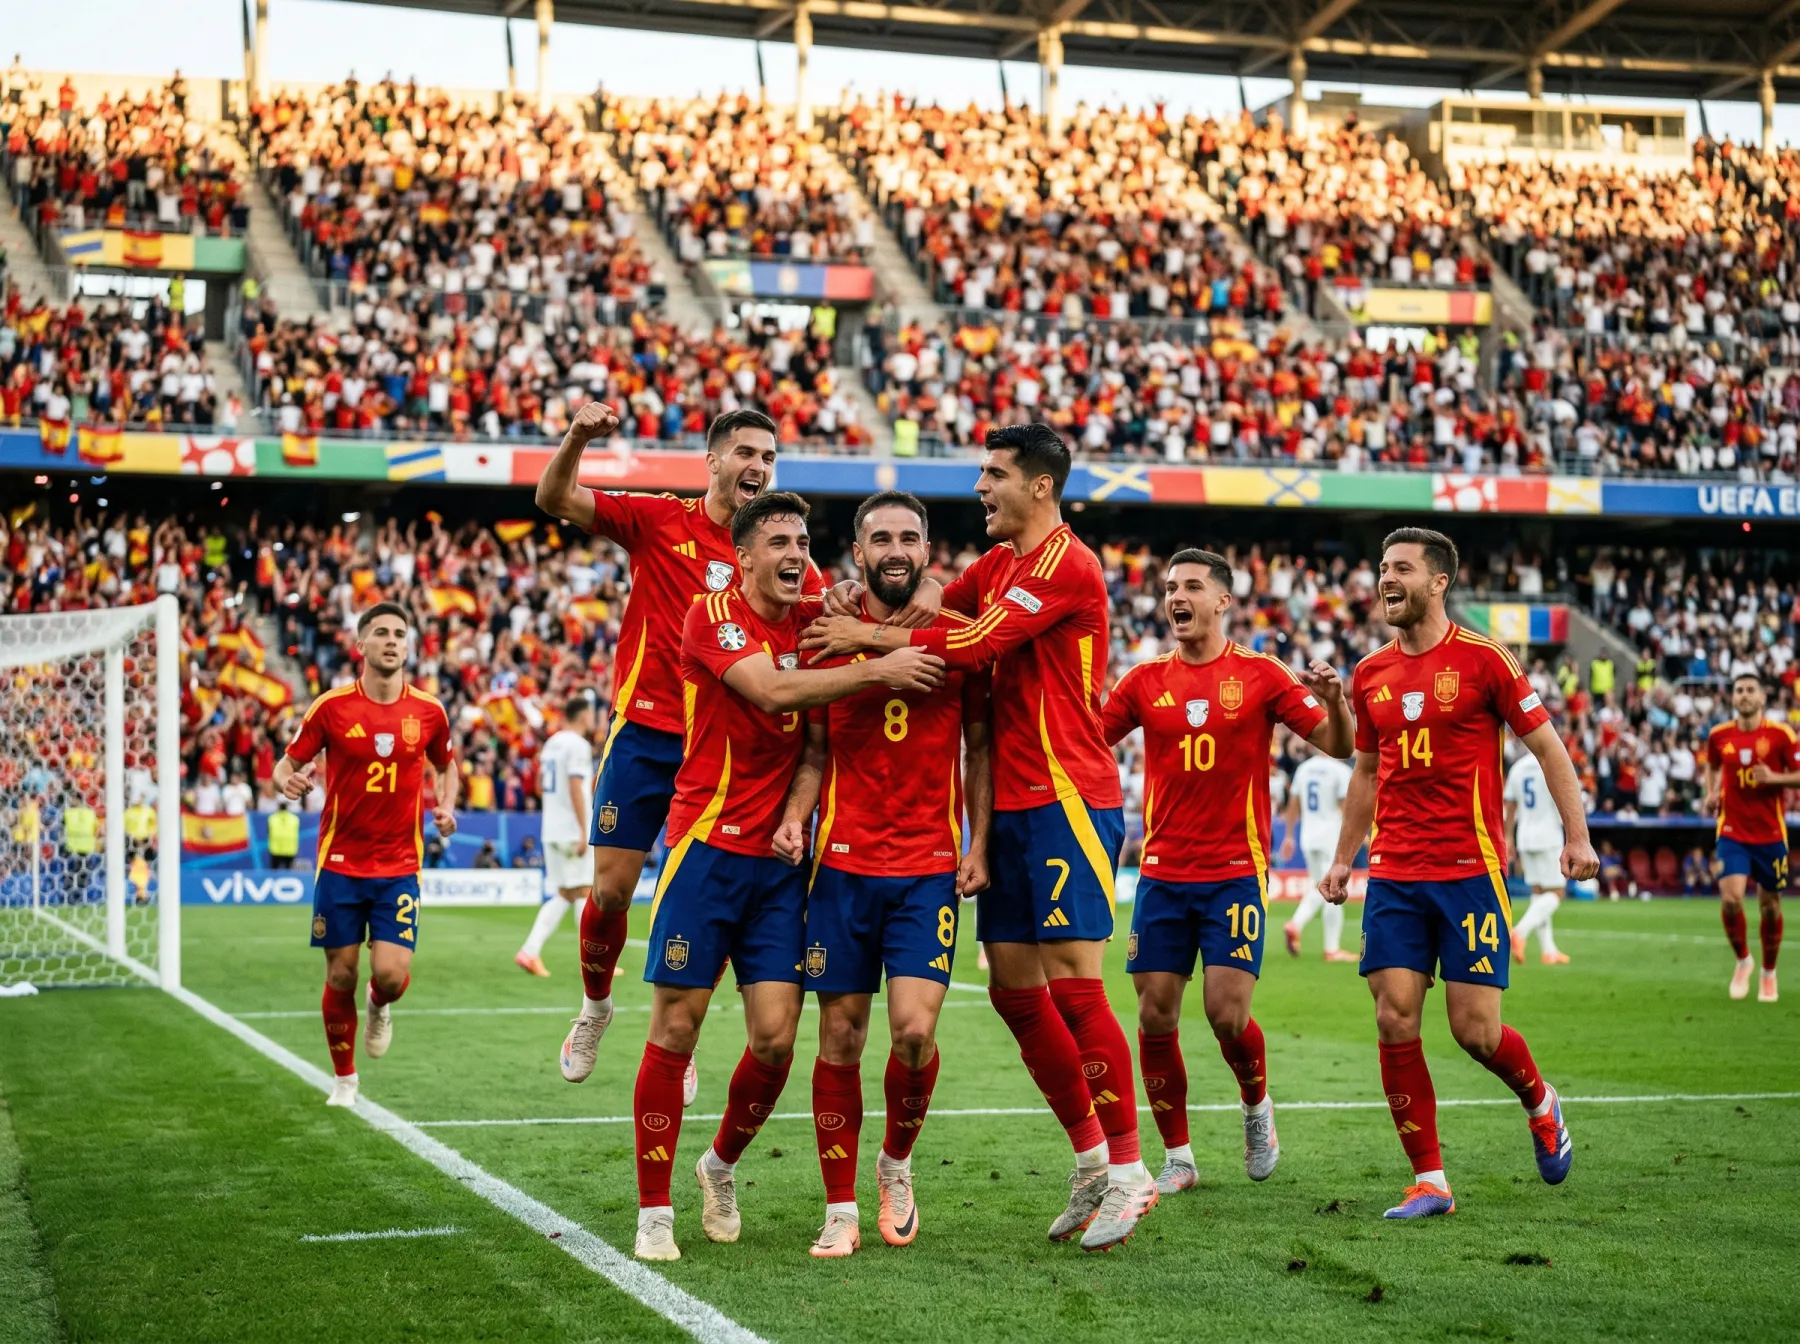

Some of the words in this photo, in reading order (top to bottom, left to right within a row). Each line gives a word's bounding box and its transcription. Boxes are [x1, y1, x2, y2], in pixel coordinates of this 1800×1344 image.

[1697, 485, 1775, 515] UEFA
[1779, 487, 1800, 515] E
[884, 699, 908, 742] 8
[1179, 733, 1216, 772] 10
[1397, 727, 1433, 769] 14
[366, 761, 397, 793] 21
[1524, 778, 1536, 809] 5
[1307, 781, 1319, 812] 6
[202, 871, 304, 902] vivo
[1046, 858, 1070, 901] 7
[396, 893, 420, 927] 21
[937, 905, 955, 948] 8
[1226, 903, 1260, 941] 10
[1461, 912, 1500, 953] 14
[648, 1116, 665, 1126] ESP
[822, 1116, 839, 1125] ESP
